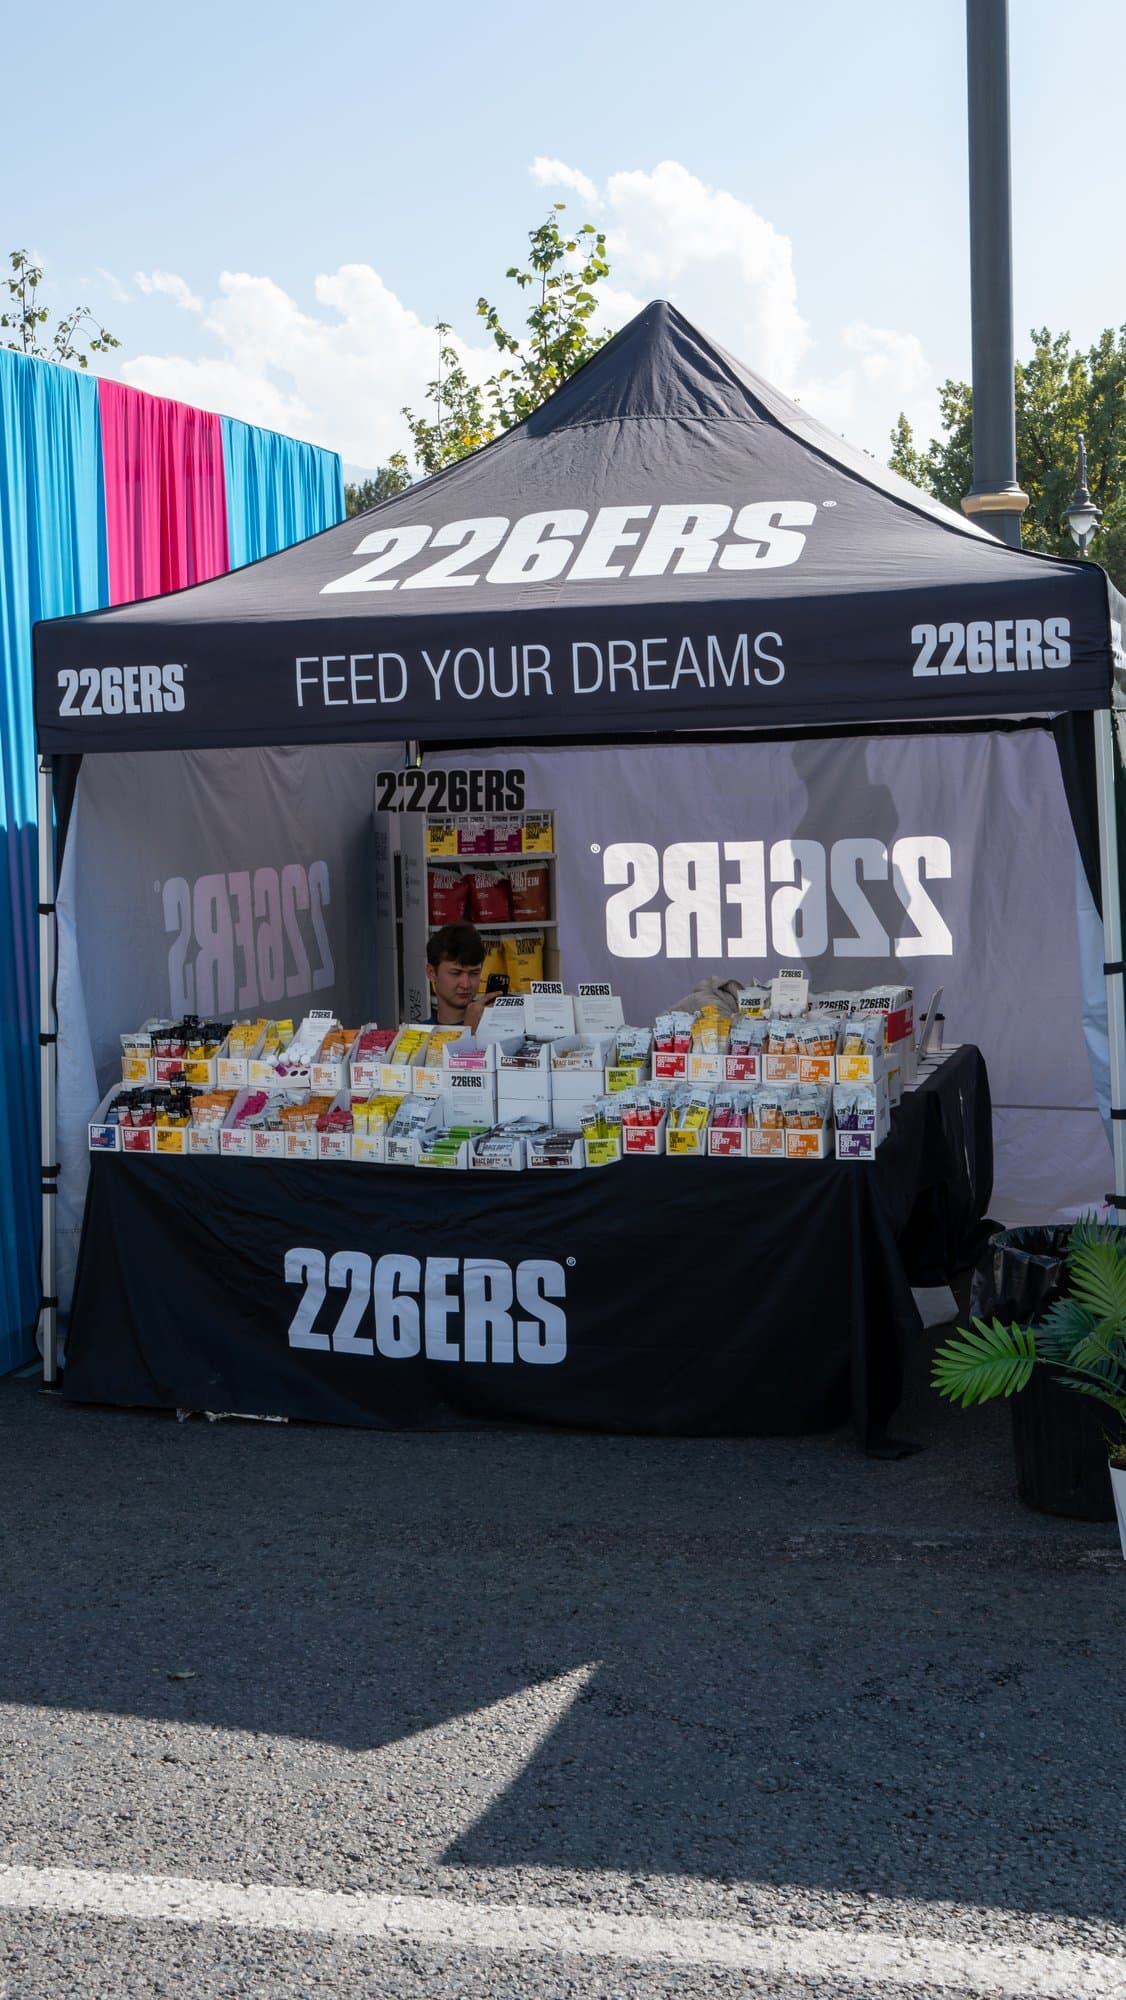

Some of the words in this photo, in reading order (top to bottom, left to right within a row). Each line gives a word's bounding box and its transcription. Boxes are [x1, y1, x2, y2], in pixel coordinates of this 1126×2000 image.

[319, 500, 818, 594] 226ERS
[911, 616, 1071, 677] 226ERS
[295, 652, 408, 708] FEED
[421, 644, 553, 701] YOUR
[572, 631, 786, 694] DREAMS
[57, 663, 186, 717] 226ERS
[404, 769, 525, 813] 226ERS
[495, 998, 525, 1007] 226ERS
[532, 983, 562, 994] 226ERS
[579, 985, 610, 996] 226ERS
[740, 998, 761, 1006] 226ERS
[859, 997, 891, 1009] 226ERS
[451, 1075, 483, 1088] 226ERS
[284, 1247, 568, 1365] 226ERS
